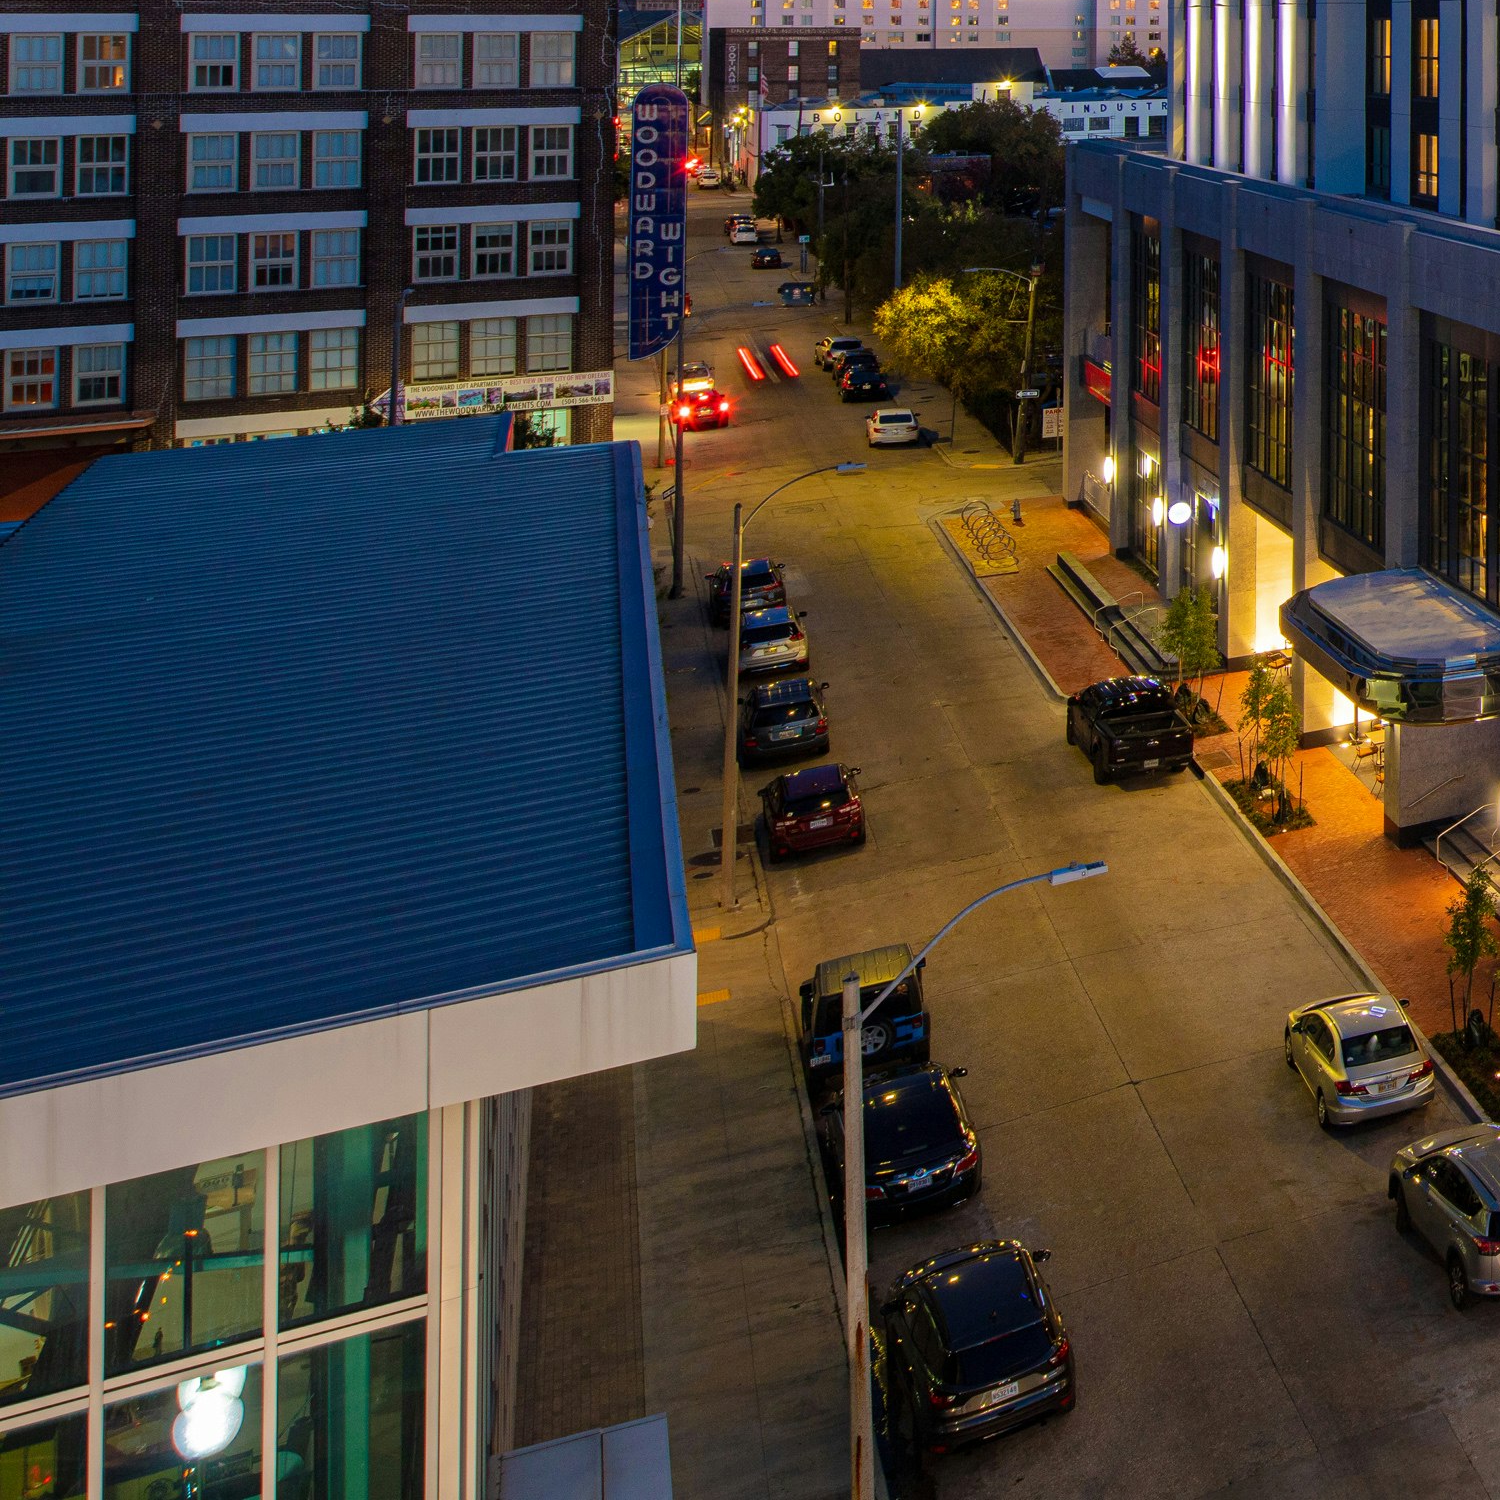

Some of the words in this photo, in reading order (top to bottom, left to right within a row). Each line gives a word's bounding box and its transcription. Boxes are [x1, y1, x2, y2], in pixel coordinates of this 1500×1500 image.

[727, 45, 736, 84] GOTHAM
[635, 103, 658, 279] WOODWARD
[659, 222, 681, 330] WIGHT
[421, 384, 455, 392] WOODWARD
[470, 380, 504, 389] APARTMENTS
[588, 371, 610, 379] ORLEANS
[415, 400, 552, 418] WWW.THEWOODWARDAPRTMENTS.COM
